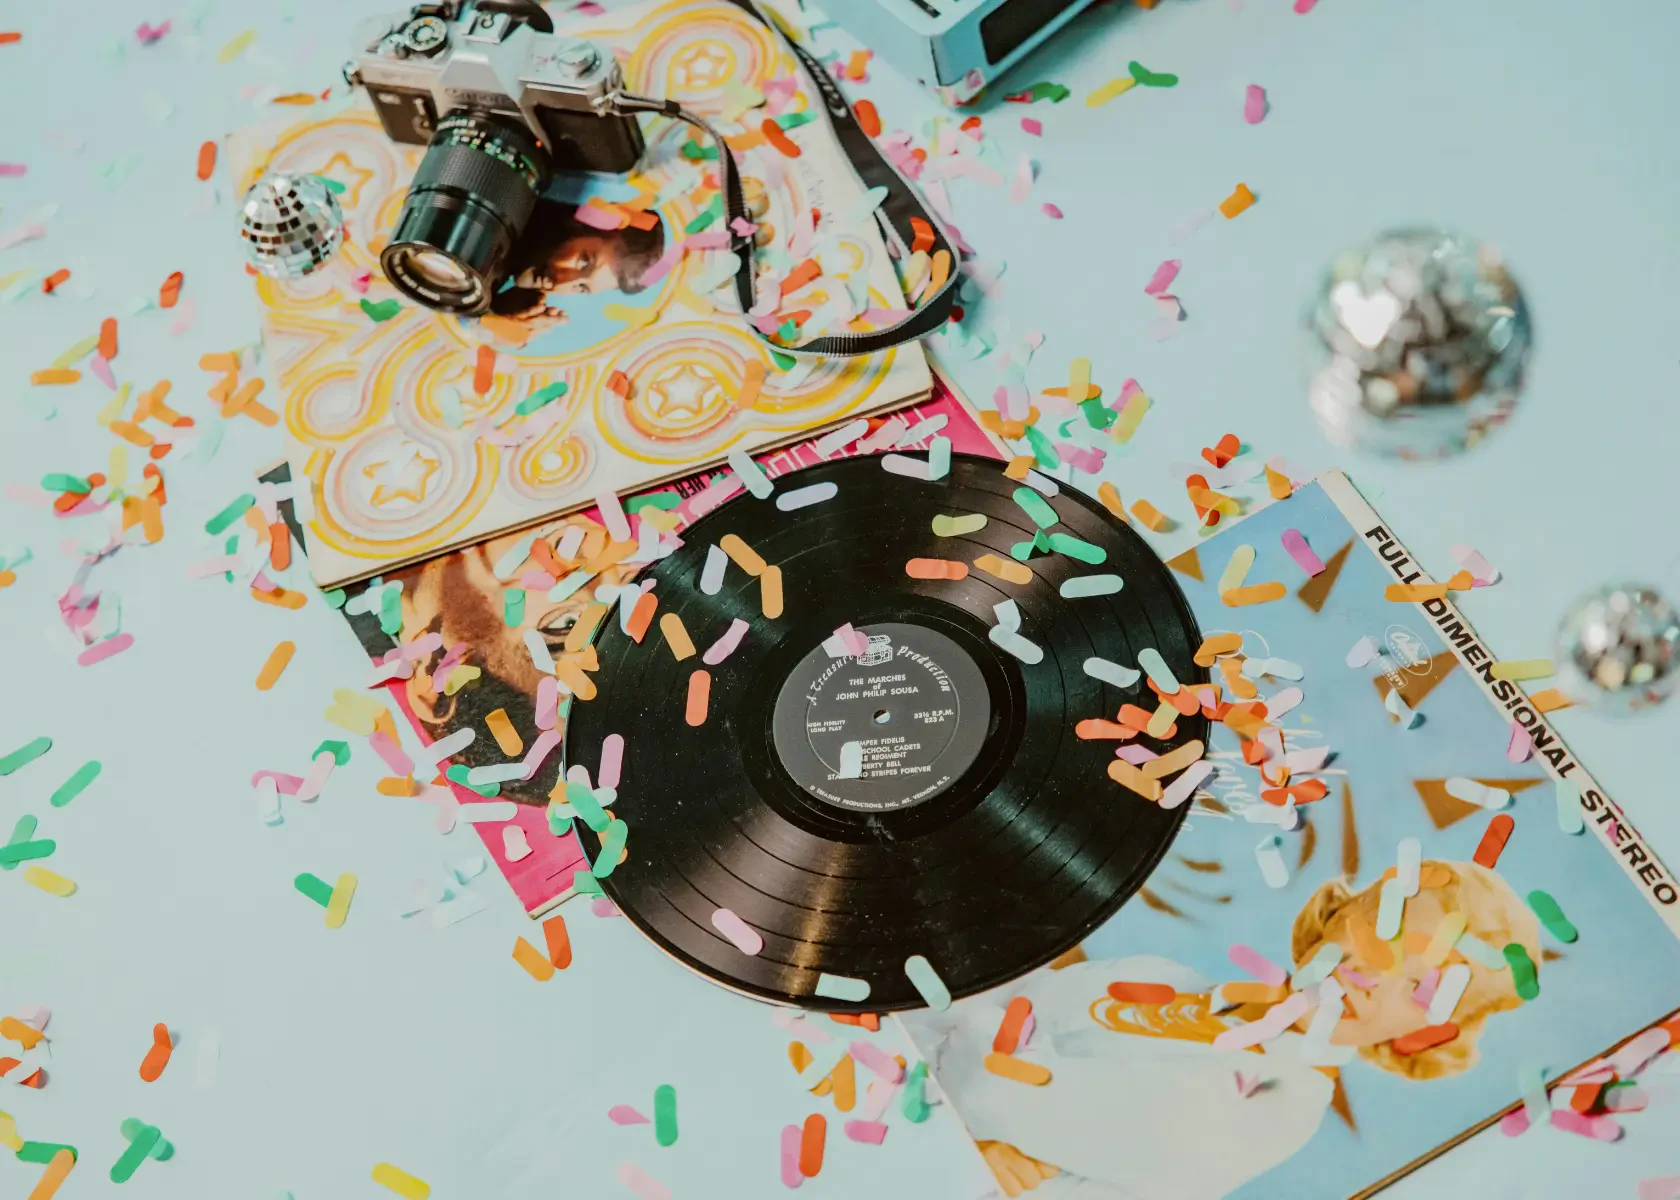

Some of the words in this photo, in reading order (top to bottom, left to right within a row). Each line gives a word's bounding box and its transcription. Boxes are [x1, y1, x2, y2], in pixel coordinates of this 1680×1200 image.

[849, 678, 864, 686] THE
[868, 674, 906, 684] MARCHES
[836, 692, 859, 700] JOHN
[863, 690, 887, 698] PHILIP
[891, 686, 919, 695] SOUSA
[932, 709, 954, 717] R.P.M.
[1365, 525, 1422, 590] FULL
[1421, 597, 1576, 778] DIMENSIONAL
[1580, 789, 1678, 905] STEREO
[862, 746, 891, 754] SCHOOL
[894, 743, 921, 751] CADETS
[871, 752, 907, 760] REGIMENT
[900, 765, 931, 774] FOREVER
[816, 788, 841, 802] TREASURE
